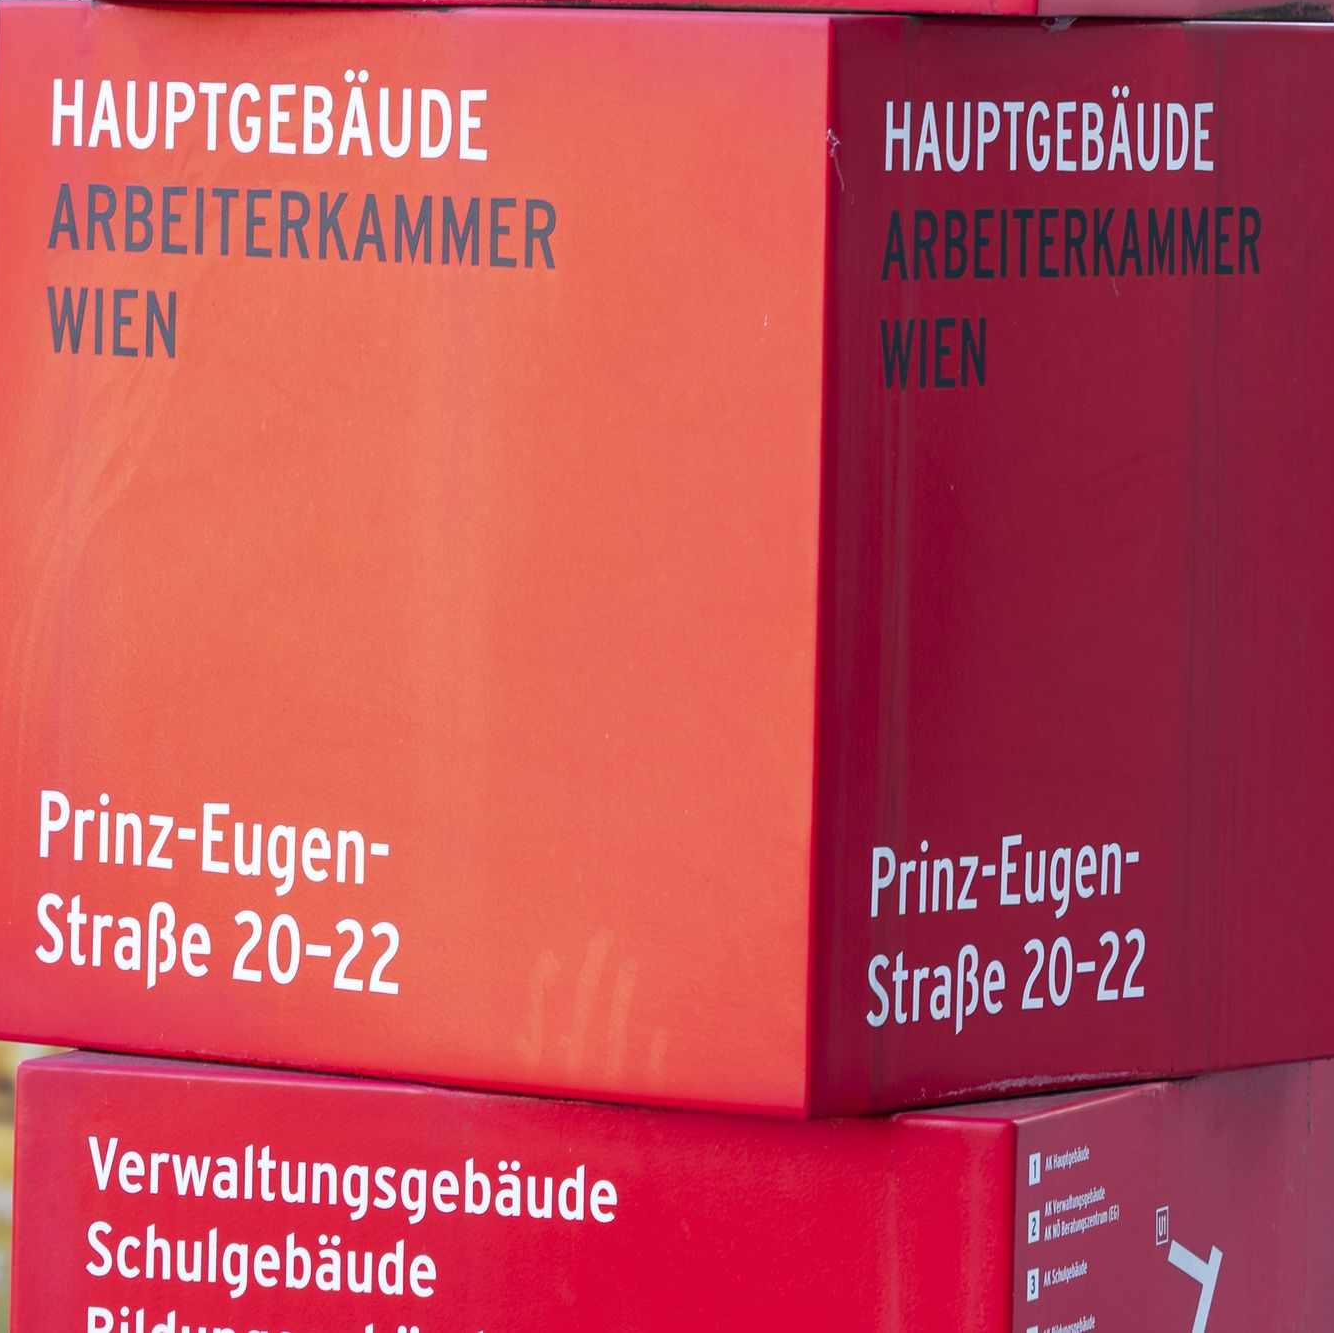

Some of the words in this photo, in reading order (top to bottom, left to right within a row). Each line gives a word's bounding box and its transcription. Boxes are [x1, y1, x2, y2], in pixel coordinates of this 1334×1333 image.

[51, 69, 488, 161] HAUPTGEBÄUDE
[884, 85, 1214, 172] HAUPTGEBÄUDE
[47, 183, 557, 269] ARBEITERKAMMER
[880, 206, 1262, 281] ARBEITERKAMMER
[47, 286, 177, 358] WIEN
[880, 317, 987, 390] WIEN
[39, 789, 390, 896] Prinz-Eugen-
[870, 834, 1139, 919] Prinz-Eugen-
[35, 892, 211, 989] Straße
[866, 944, 1006, 1036] Straße
[87, 1136, 618, 1224] Verwaltungsgebäude
[1045, 1155, 1053, 1172] AK
[1043, 1224, 1052, 1241] AK
[1044, 1200, 1052, 1217] AK
[86, 1222, 437, 1298] Schulgebäude
[1043, 1270, 1051, 1287] AK
